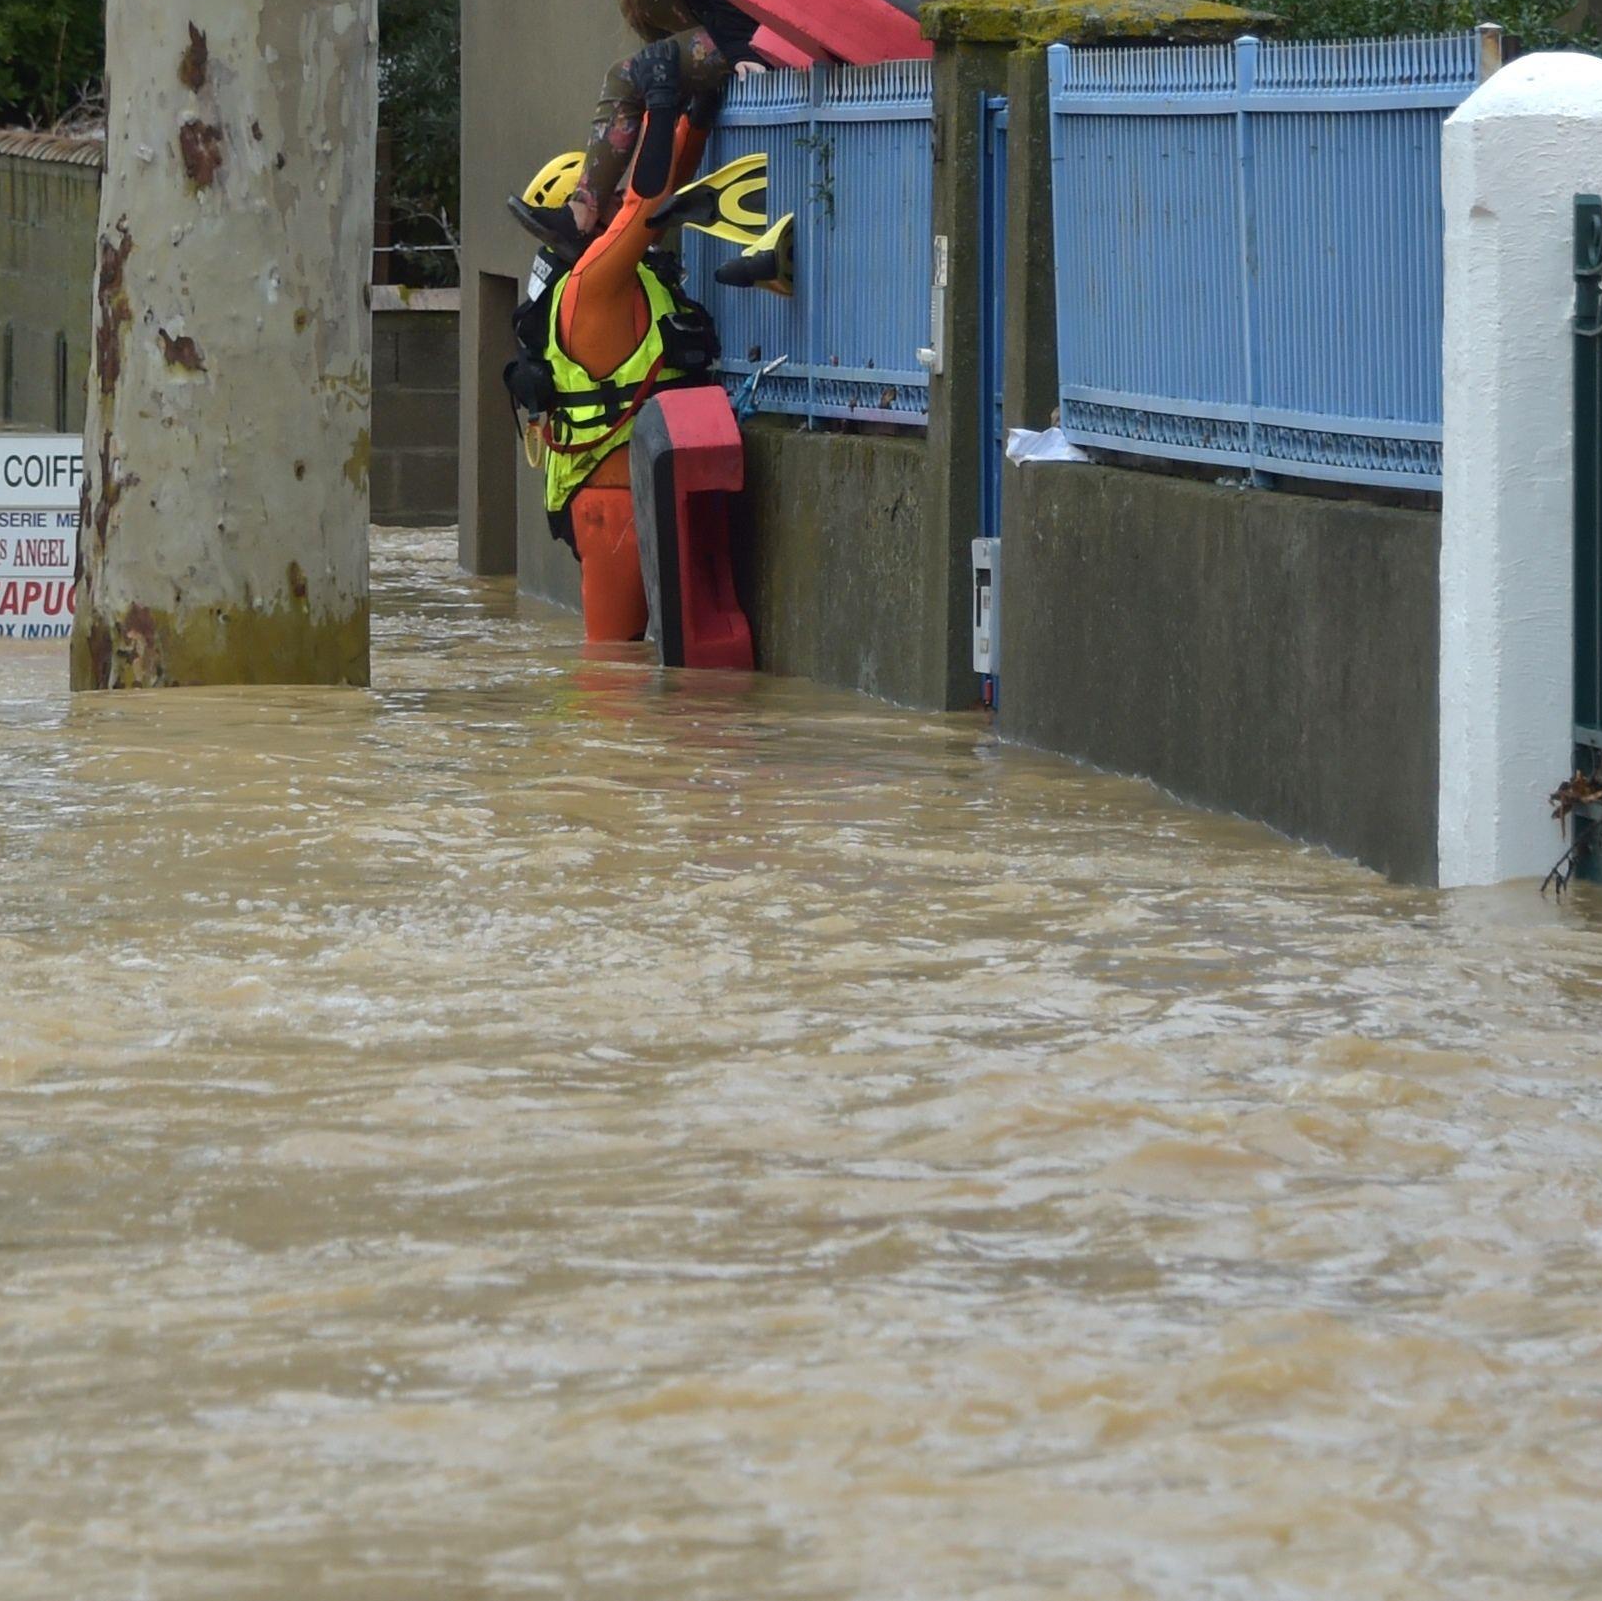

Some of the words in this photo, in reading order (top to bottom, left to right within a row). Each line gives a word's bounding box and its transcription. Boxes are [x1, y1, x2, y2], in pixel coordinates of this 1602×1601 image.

[3, 454, 83, 488] COIFF
[56, 512, 80, 528] ME
[13, 538, 69, 567] ANGEL
